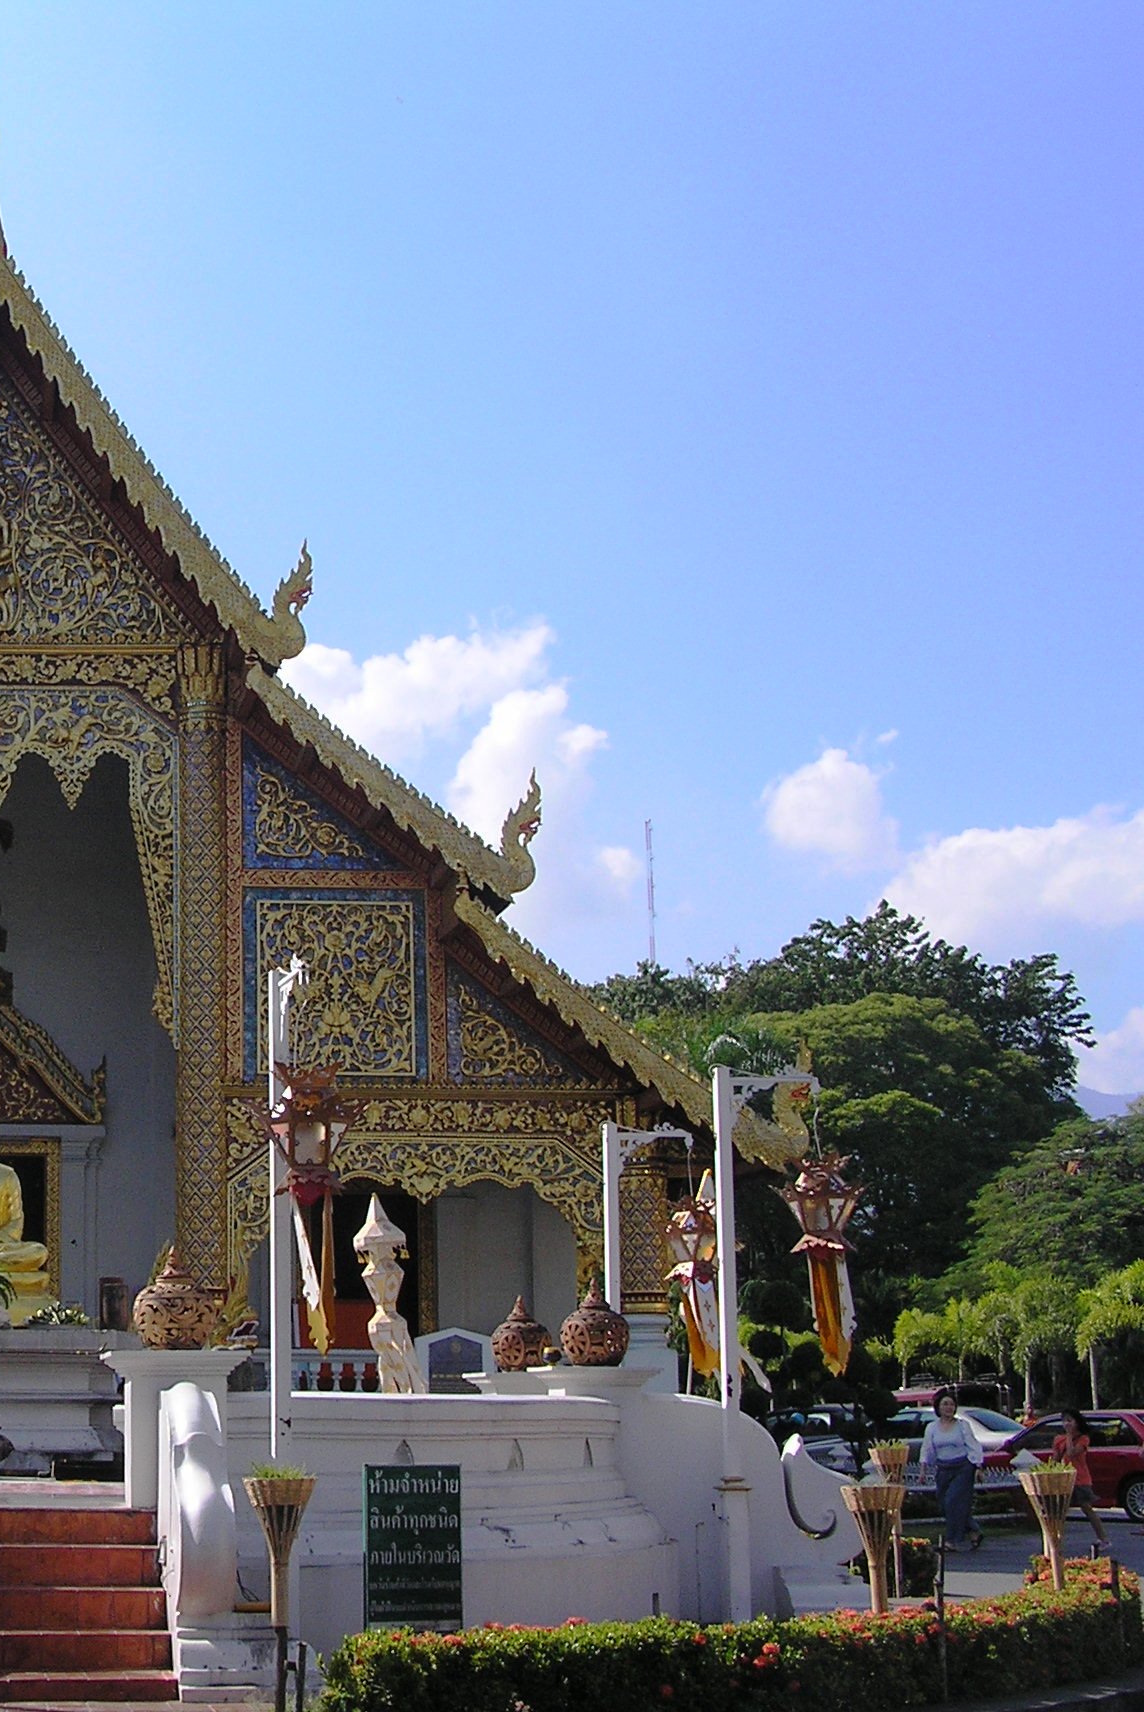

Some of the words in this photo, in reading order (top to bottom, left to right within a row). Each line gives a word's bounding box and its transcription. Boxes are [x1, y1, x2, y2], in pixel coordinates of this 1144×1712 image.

[369, 1470, 459, 1494] ห้ามจำหน่าย
